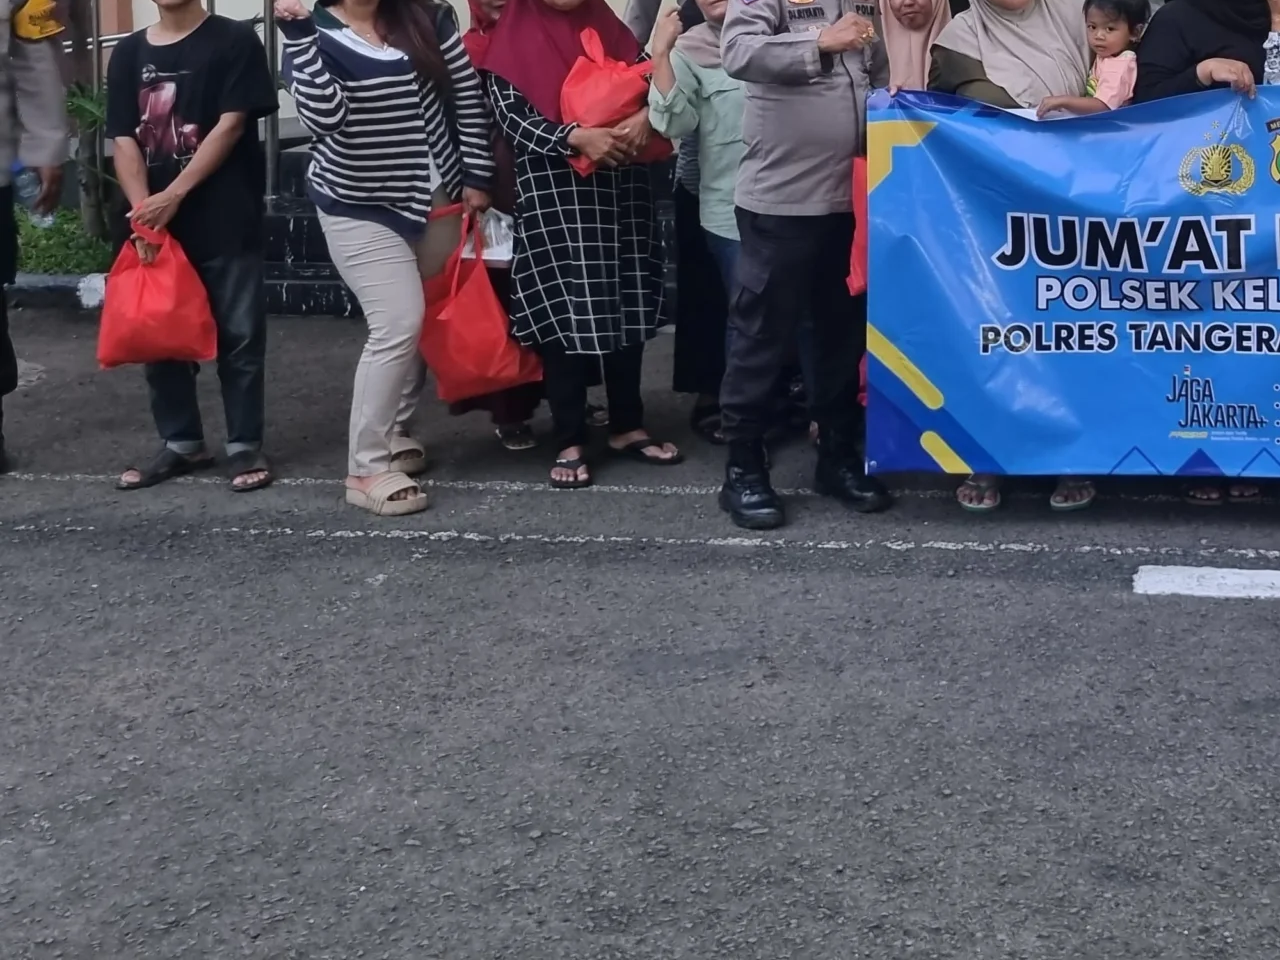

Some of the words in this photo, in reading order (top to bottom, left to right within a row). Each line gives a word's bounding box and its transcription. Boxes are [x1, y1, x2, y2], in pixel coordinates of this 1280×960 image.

[992, 212, 1255, 273] JUM'AT
[1036, 276, 1203, 311] POLSEK
[980, 321, 1118, 355] POLRES
[1166, 373, 1214, 403] JAGA
